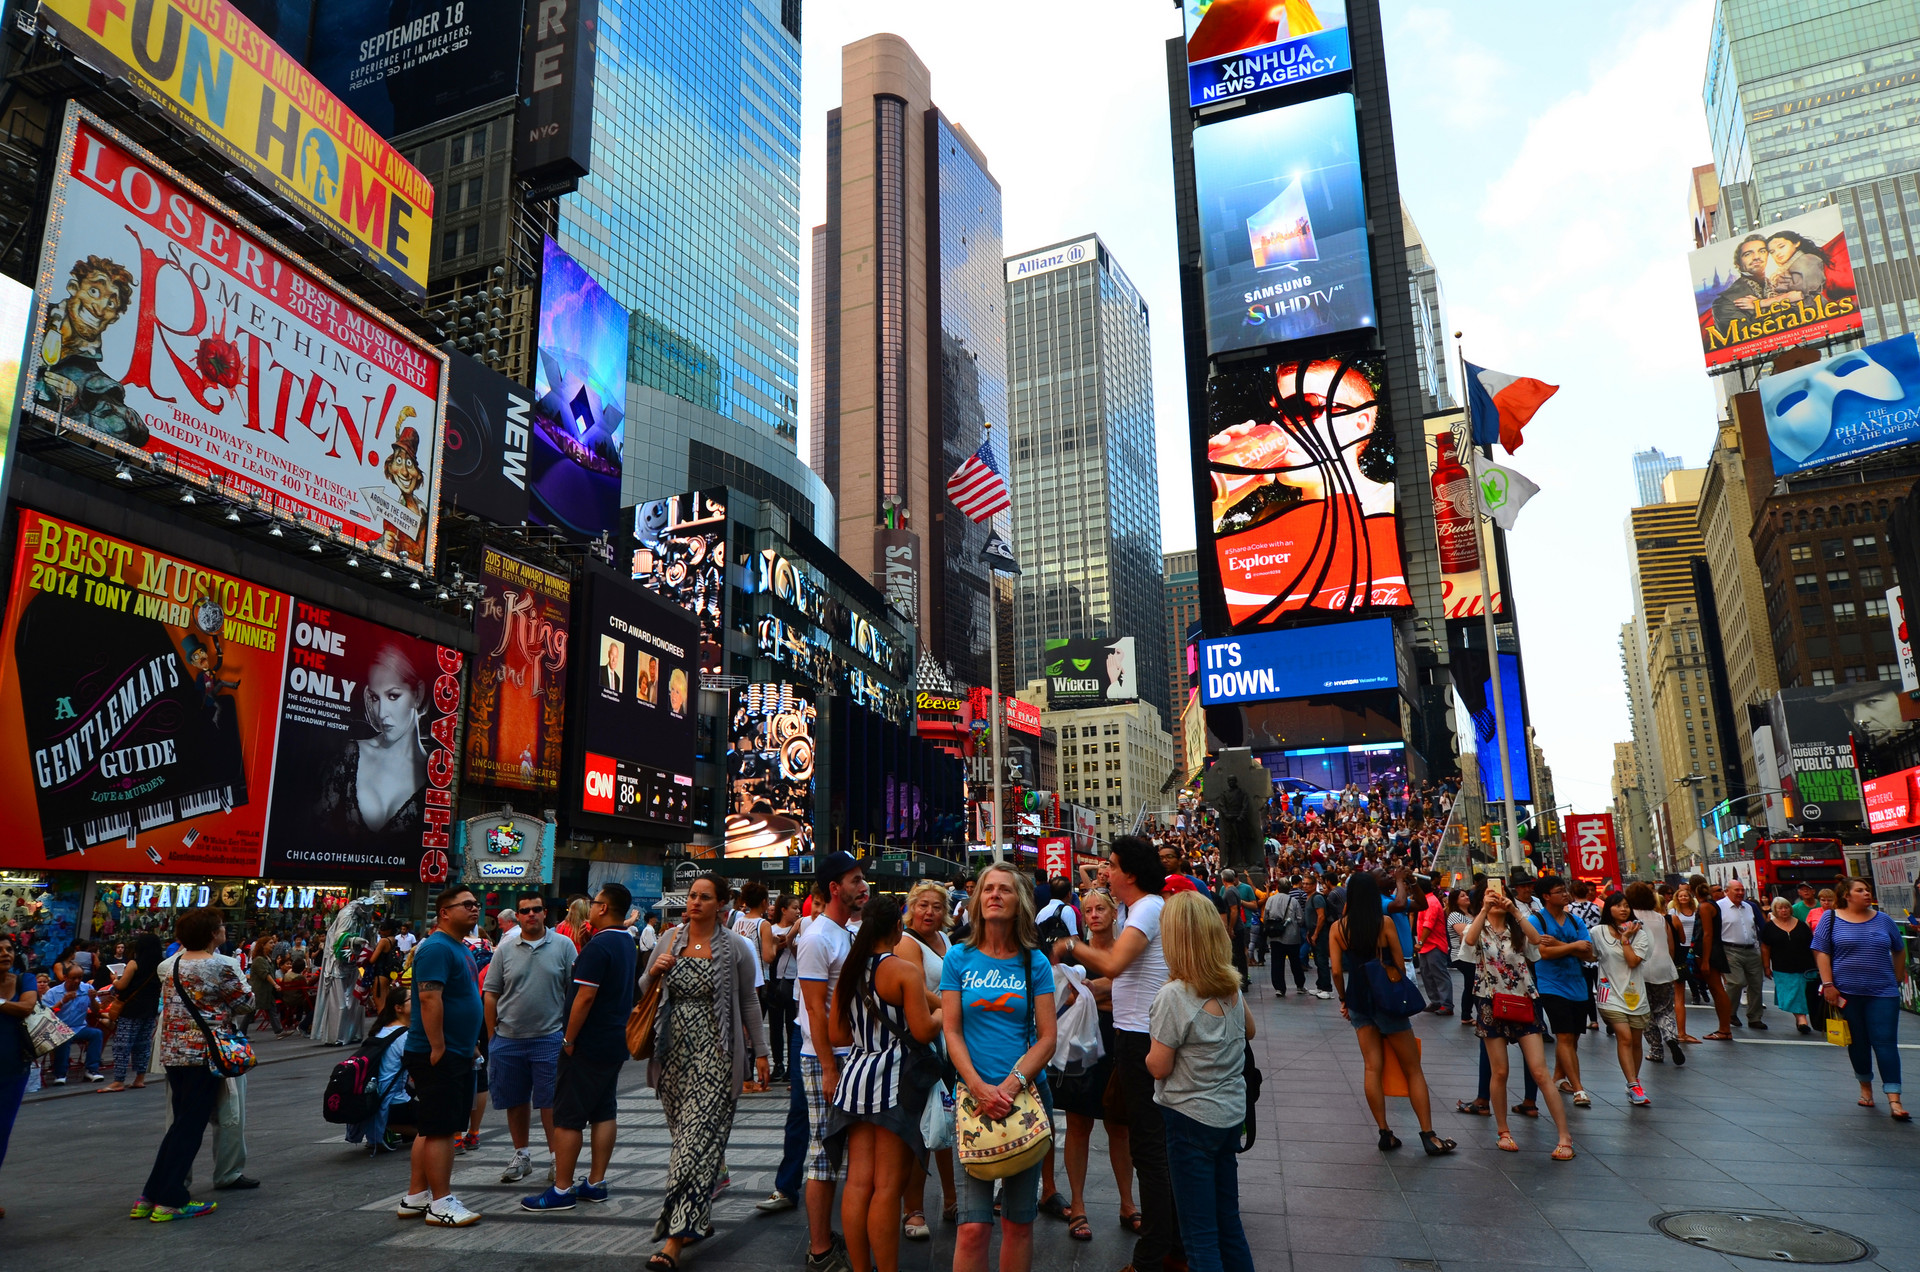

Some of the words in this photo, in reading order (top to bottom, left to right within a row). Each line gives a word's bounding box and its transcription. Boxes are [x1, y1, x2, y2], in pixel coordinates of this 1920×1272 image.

[359, 13, 440, 62] SEPTEMBER
[444, 1, 465, 29] 18
[86, 0, 234, 130] FUN
[350, 52, 399, 81] EXPERIENCE
[402, 48, 411, 61] IT
[414, 44, 423, 55] IN
[427, 25, 472, 51] THEATERS,
[387, 65, 401, 77] 3D
[403, 58, 416, 71] AND
[418, 48, 449, 65] IMAX
[452, 39, 469, 52] 3D
[1221, 43, 1315, 81] XINHUA
[1202, 76, 1256, 100] NEWS
[1258, 55, 1337, 86] AGENCY
[182, 0, 221, 31] 015
[223, 10, 271, 74] BEST
[272, 52, 343, 137] MUSICAL
[346, 115, 384, 169] TONY
[385, 149, 432, 212] AWARD
[138, 78, 167, 107] CIRCLE
[168, 103, 178, 114] IN
[179, 110, 195, 129] THE
[195, 121, 225, 153] SQUARE
[226, 144, 258, 173] THEATRE
[529, 122, 560, 143] NYC
[78, 132, 282, 298] LOSER!
[1017, 253, 1064, 275] Allianz
[1244, 275, 1312, 303] SAMSUNG
[165, 241, 372, 384] SOMETHING
[1705, 294, 1854, 350] Misérables
[1753, 298, 1792, 319] Les
[290, 272, 340, 318] BEST
[345, 309, 428, 375] MUSICAL!
[1773, 331, 1800, 342] IMPERIAL
[1802, 324, 1829, 334] THEATRE
[287, 292, 322, 324] 2015
[326, 317, 372, 355] TONY
[373, 348, 427, 388] AWARD
[1835, 406, 1920, 440] PHANTOM
[1865, 406, 1888, 419] THE
[502, 392, 531, 491] NEW
[1843, 438, 1856, 446] OF
[1860, 431, 1881, 441] THE
[1883, 420, 1920, 435] OPERA
[144, 413, 203, 448] COMEDY
[206, 441, 220, 456] IN
[222, 449, 239, 464] AT
[242, 457, 278, 481] LEAST
[280, 474, 301, 492] 400
[1802, 457, 1826, 467] MAJESTIC
[1826, 452, 1849, 462] THEATRE
[256, 447, 311, 482] FUNNIEST
[314, 475, 359, 503] MUSICAL
[370, 492, 390, 510] AROUND
[390, 504, 400, 514] THE
[400, 511, 418, 529] CORNER
[376, 505, 383, 514] ON
[394, 516, 411, 531] STREET
[1268, 540, 1284, 548] with
[33, 518, 134, 585] BEST
[137, 550, 281, 630] MUSICAL!
[485, 550, 500, 567] 2015
[502, 557, 519, 574] TONY
[520, 565, 544, 583] AWARD
[544, 573, 571, 594] WINNER!
[1228, 553, 1291, 571] Explorer
[485, 563, 500, 577] BEST
[502, 570, 529, 588] REVIVAL
[529, 579, 538, 590] OF
[544, 587, 570, 602] MUSICAL
[28, 563, 79, 599] 2014
[84, 578, 132, 613] TONY
[133, 593, 191, 629] AWARD
[222, 618, 276, 652] WINNER
[297, 602, 331, 626] THE
[480, 597, 503, 620] The
[295, 622, 347, 657] ONE
[491, 591, 569, 672] King
[609, 615, 628, 633] CTFD
[628, 624, 652, 644] AWARD
[652, 635, 685, 658] HONOREES
[293, 647, 326, 671] THE
[1206, 642, 1242, 669] IT'S
[290, 667, 357, 703] ONLY
[1208, 668, 1280, 699] DOWN.
[54, 696, 77, 720] A
[286, 703, 316, 718] AMERICAN
[317, 709, 341, 720] MUSICAL
[287, 693, 298, 702] THE
[299, 695, 351, 712] LONGEST-RUNNING
[916, 692, 962, 710] Reese's
[34, 652, 179, 788] GENTLEMAN'S
[291, 714, 327, 728] BROADWAY
[327, 720, 350, 731] HISTORY
[100, 738, 177, 779] GUIDE
[419, 644, 464, 883] CHICAGO
[472, 758, 501, 771] LINCOLN
[1792, 747, 1823, 757] AUGUST
[1824, 746, 1835, 756] 25
[1794, 756, 1832, 771] PUBLIC
[125, 775, 165, 800] MURDER
[586, 770, 614, 799] CNN
[617, 774, 627, 783] NEW
[1798, 769, 1853, 788] ALWAYS
[620, 783, 635, 804] 88
[1800, 785, 1839, 803] YOUR
[1869, 810, 1885, 823] EXTRA
[1884, 808, 1896, 820] 25%
[1896, 805, 1906, 817] OFF
[286, 849, 406, 866] CHICAGOTHEMUSICAL.COM
[1577, 819, 1608, 871] tkts
[684, 869, 696, 878] HOT
[121, 883, 211, 909] GRAND
[256, 885, 316, 909] SLAM
